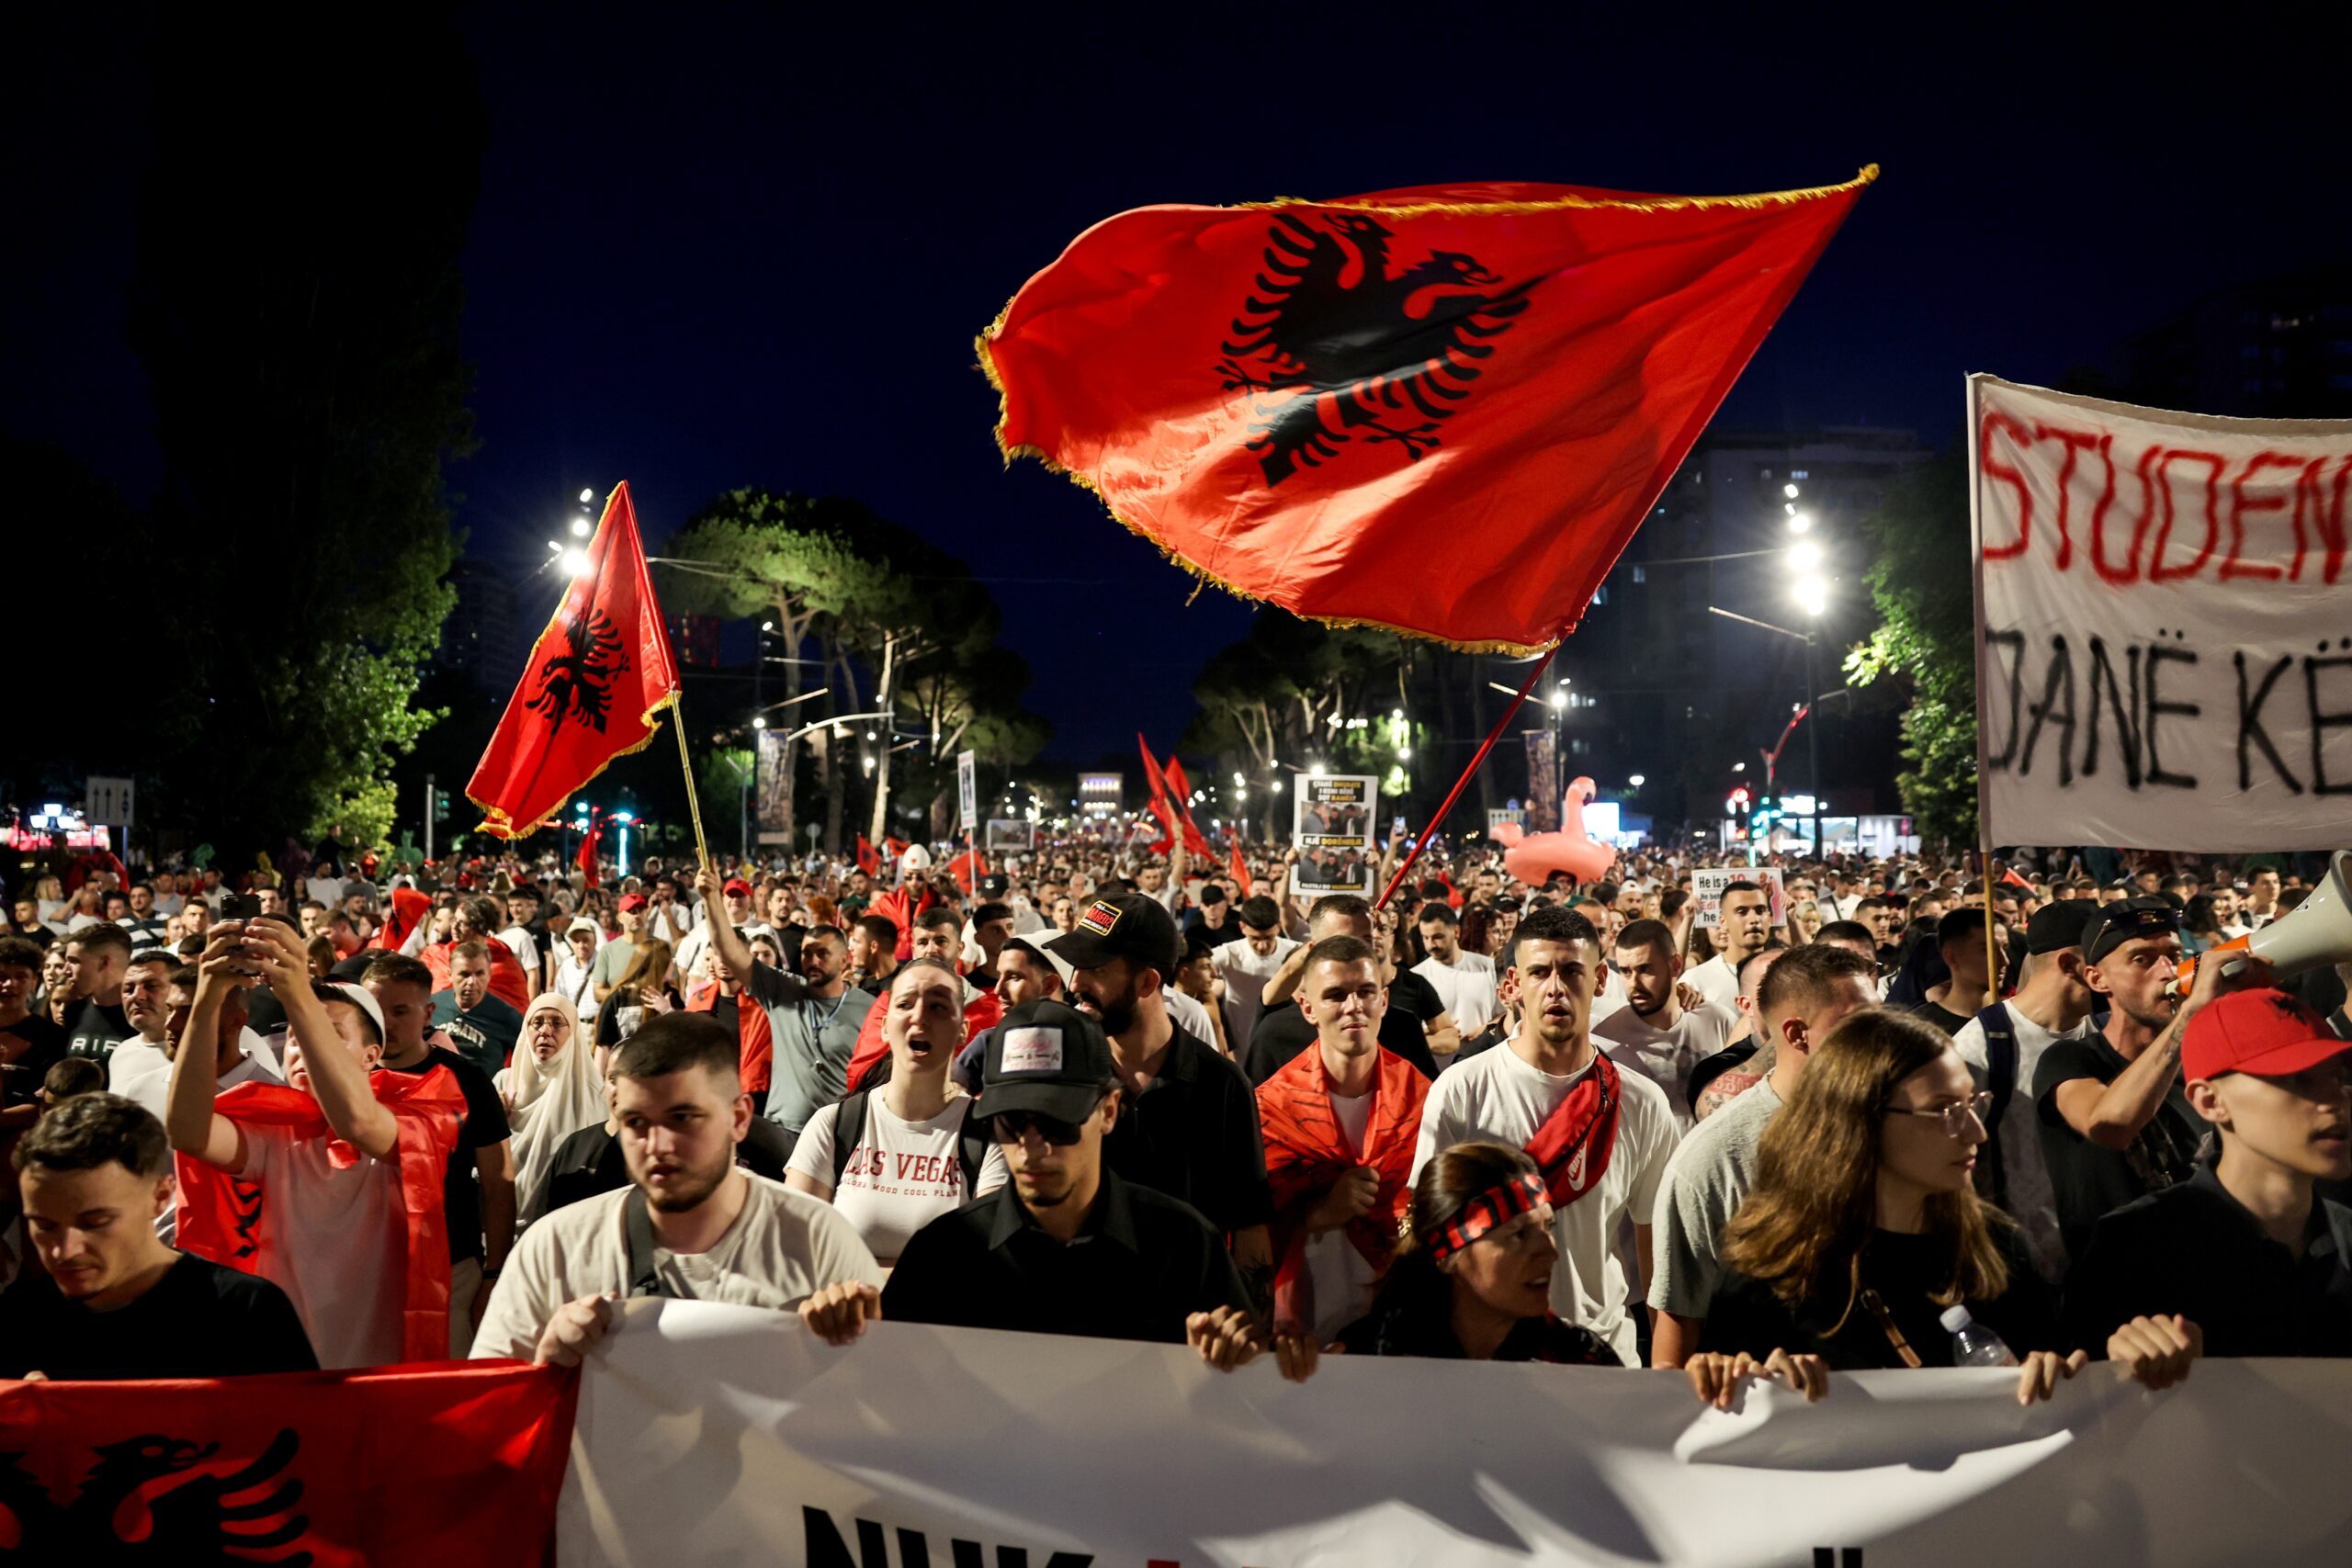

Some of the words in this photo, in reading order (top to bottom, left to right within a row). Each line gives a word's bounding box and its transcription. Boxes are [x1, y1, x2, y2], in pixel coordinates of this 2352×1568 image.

[1982, 412, 2352, 584] STUDEN
[1985, 628, 2200, 788] JANË
[1699, 876, 1710, 888] He
[1713, 875, 1722, 887] is
[1724, 878, 1728, 887] a
[1703, 912, 1716, 921] he
[845, 1147, 886, 1176] LAS
[872, 1185, 898, 1194] MOOD
